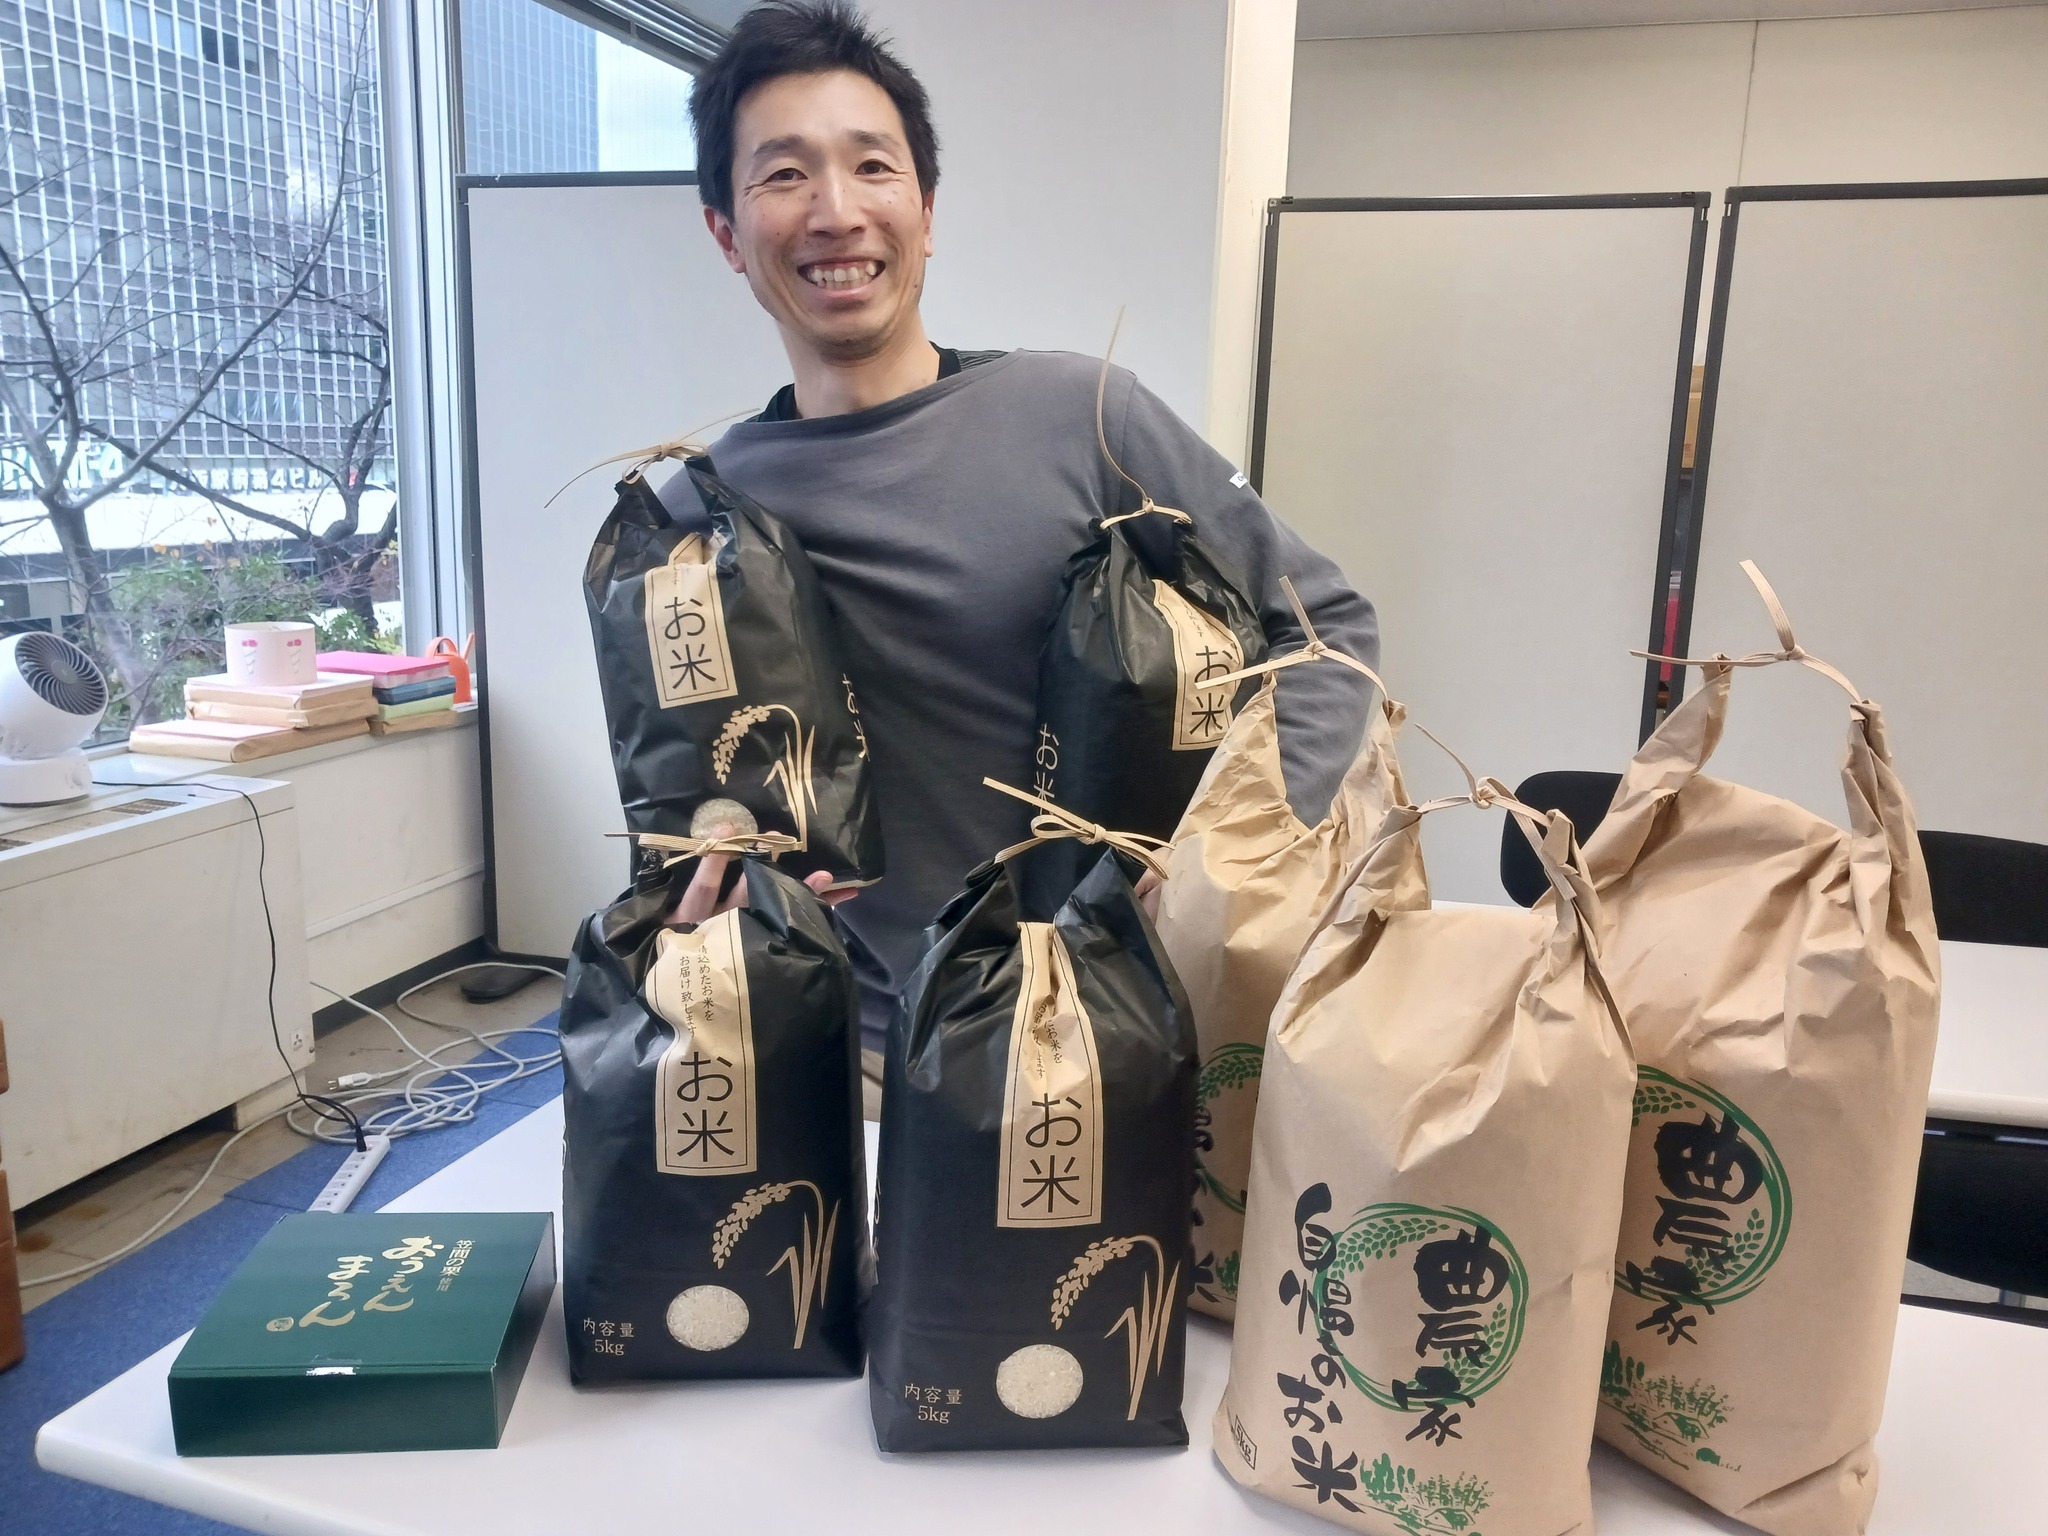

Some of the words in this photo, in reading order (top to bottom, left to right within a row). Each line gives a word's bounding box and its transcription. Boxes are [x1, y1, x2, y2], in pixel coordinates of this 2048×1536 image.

[664, 596, 717, 691] お米
[1190, 645, 1233, 738] お米
[680, 956, 697, 1038] お届け致します
[676, 1050, 736, 1164] お米
[1021, 1092, 1083, 1214] お米
[1625, 1110, 1766, 1346] 農家
[299, 1255, 374, 1328] まろん
[363, 1236, 445, 1312] おうえん
[583, 1317, 634, 1338] 内容量
[594, 1339, 625, 1356] 5kg
[1277, 1181, 1367, 1514] 自慢のお米
[1391, 1225, 1510, 1447] 農家
[904, 1383, 962, 1405] 内容量
[917, 1405, 950, 1425] 5kg
[1236, 1425, 1252, 1462] 5kg
